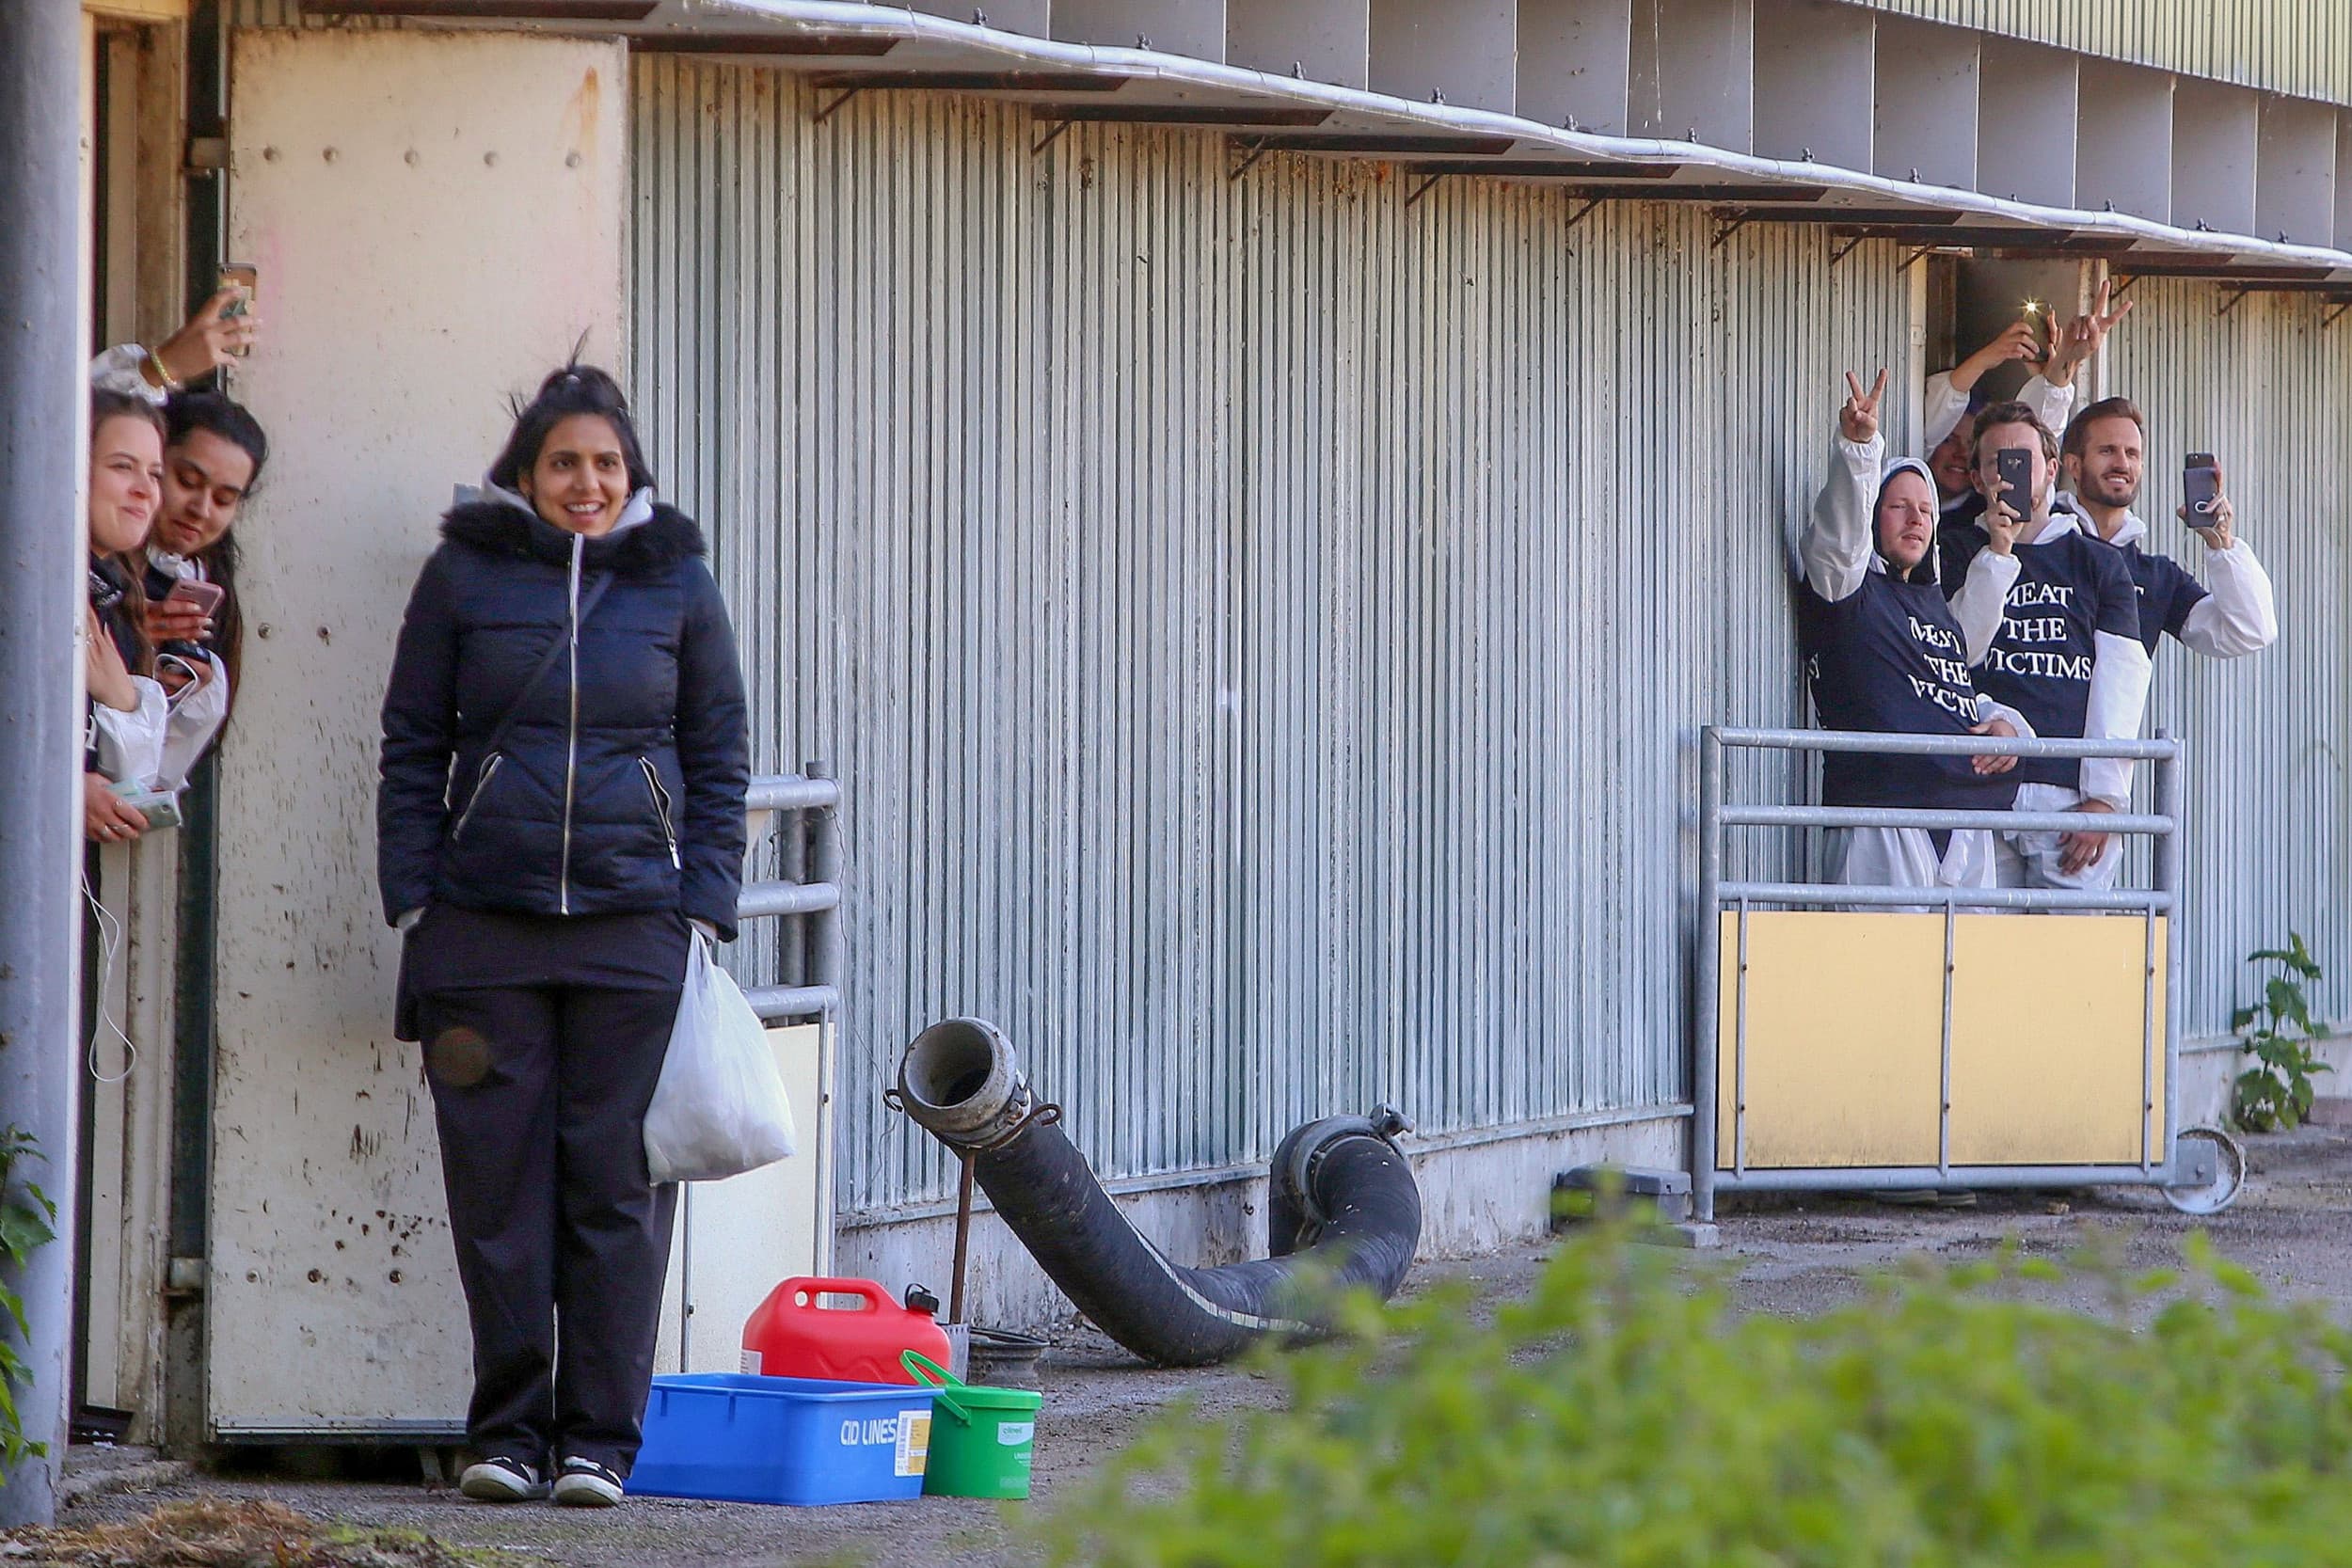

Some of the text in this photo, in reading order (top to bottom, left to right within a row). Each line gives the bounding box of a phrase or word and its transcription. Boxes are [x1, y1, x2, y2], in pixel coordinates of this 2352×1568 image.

[2003, 616, 2067, 642] THE
[1923, 653, 1972, 687] THE
[1984, 647, 2091, 680] VICTIMS
[840, 1419, 859, 1446] CID
[862, 1418, 898, 1446] LINES
